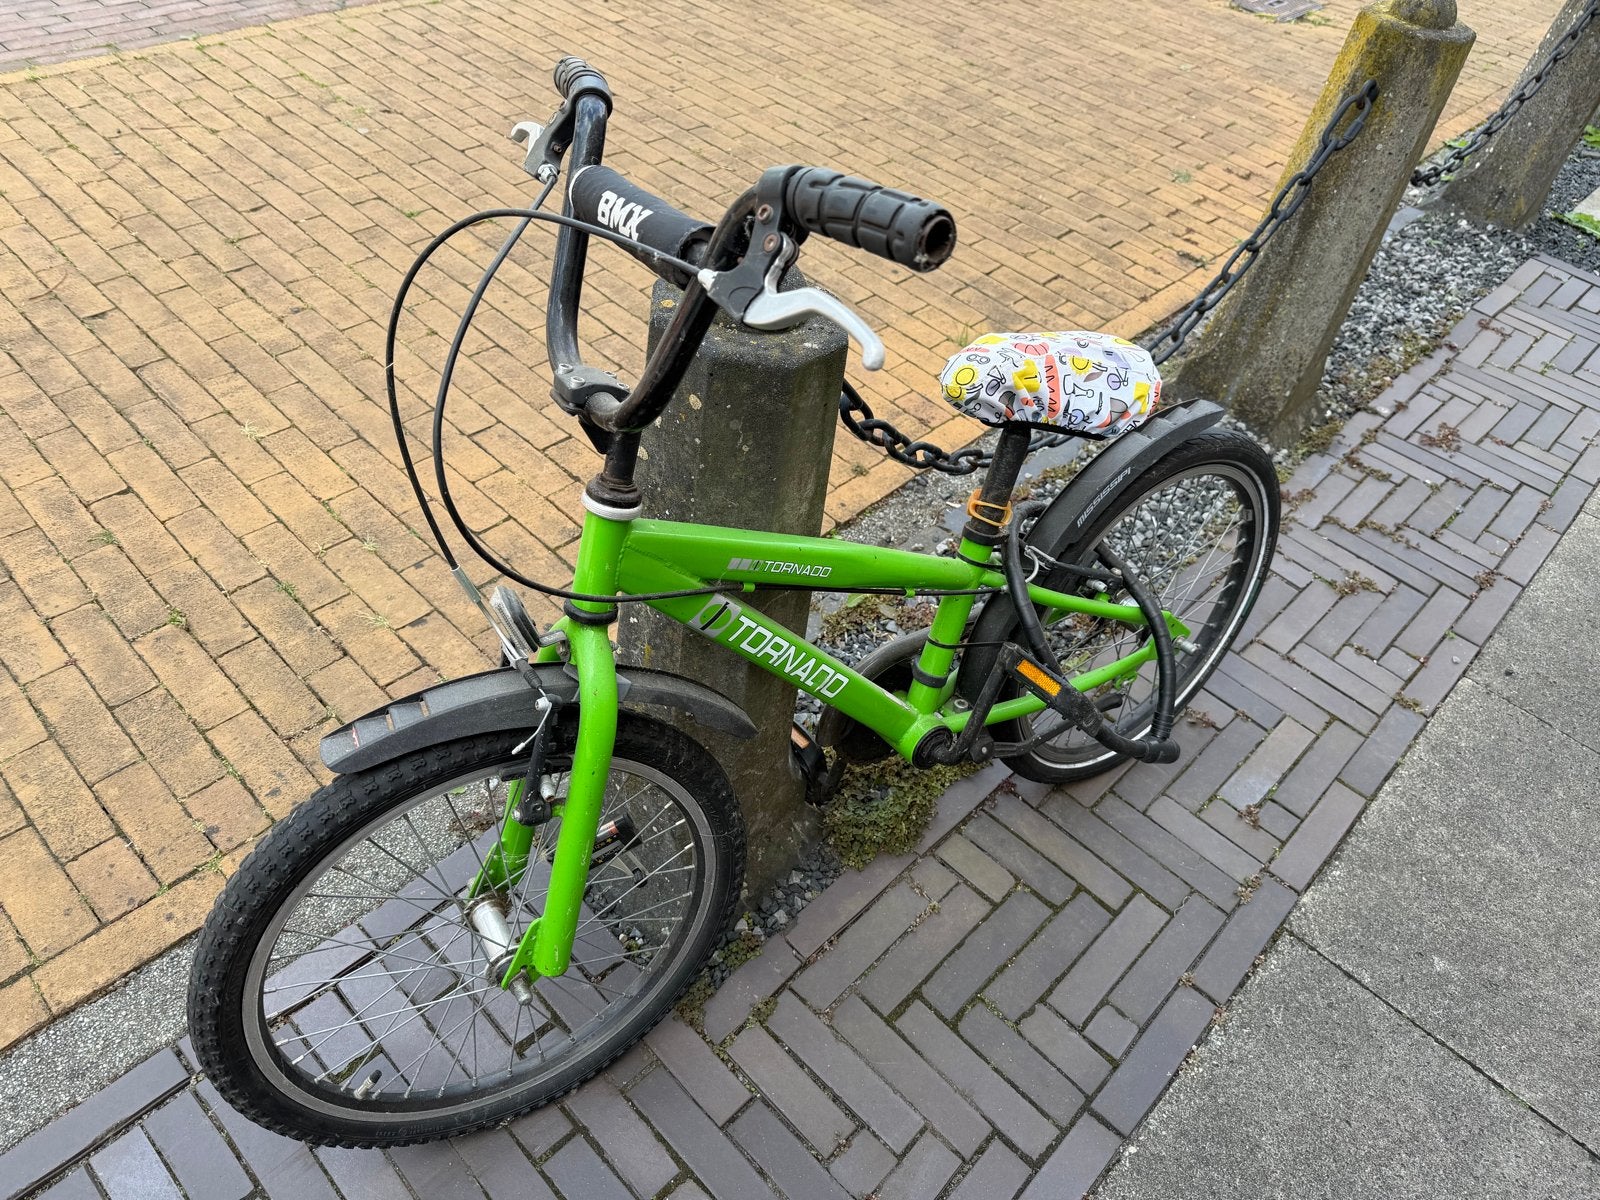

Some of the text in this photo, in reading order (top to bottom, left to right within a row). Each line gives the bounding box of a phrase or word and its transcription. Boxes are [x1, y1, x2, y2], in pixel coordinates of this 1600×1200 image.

[597, 190, 654, 242] BMX
[1076, 466, 1132, 528] MISSISSIPI
[763, 560, 832, 578] TORNADO
[727, 615, 850, 699] TORNADO
